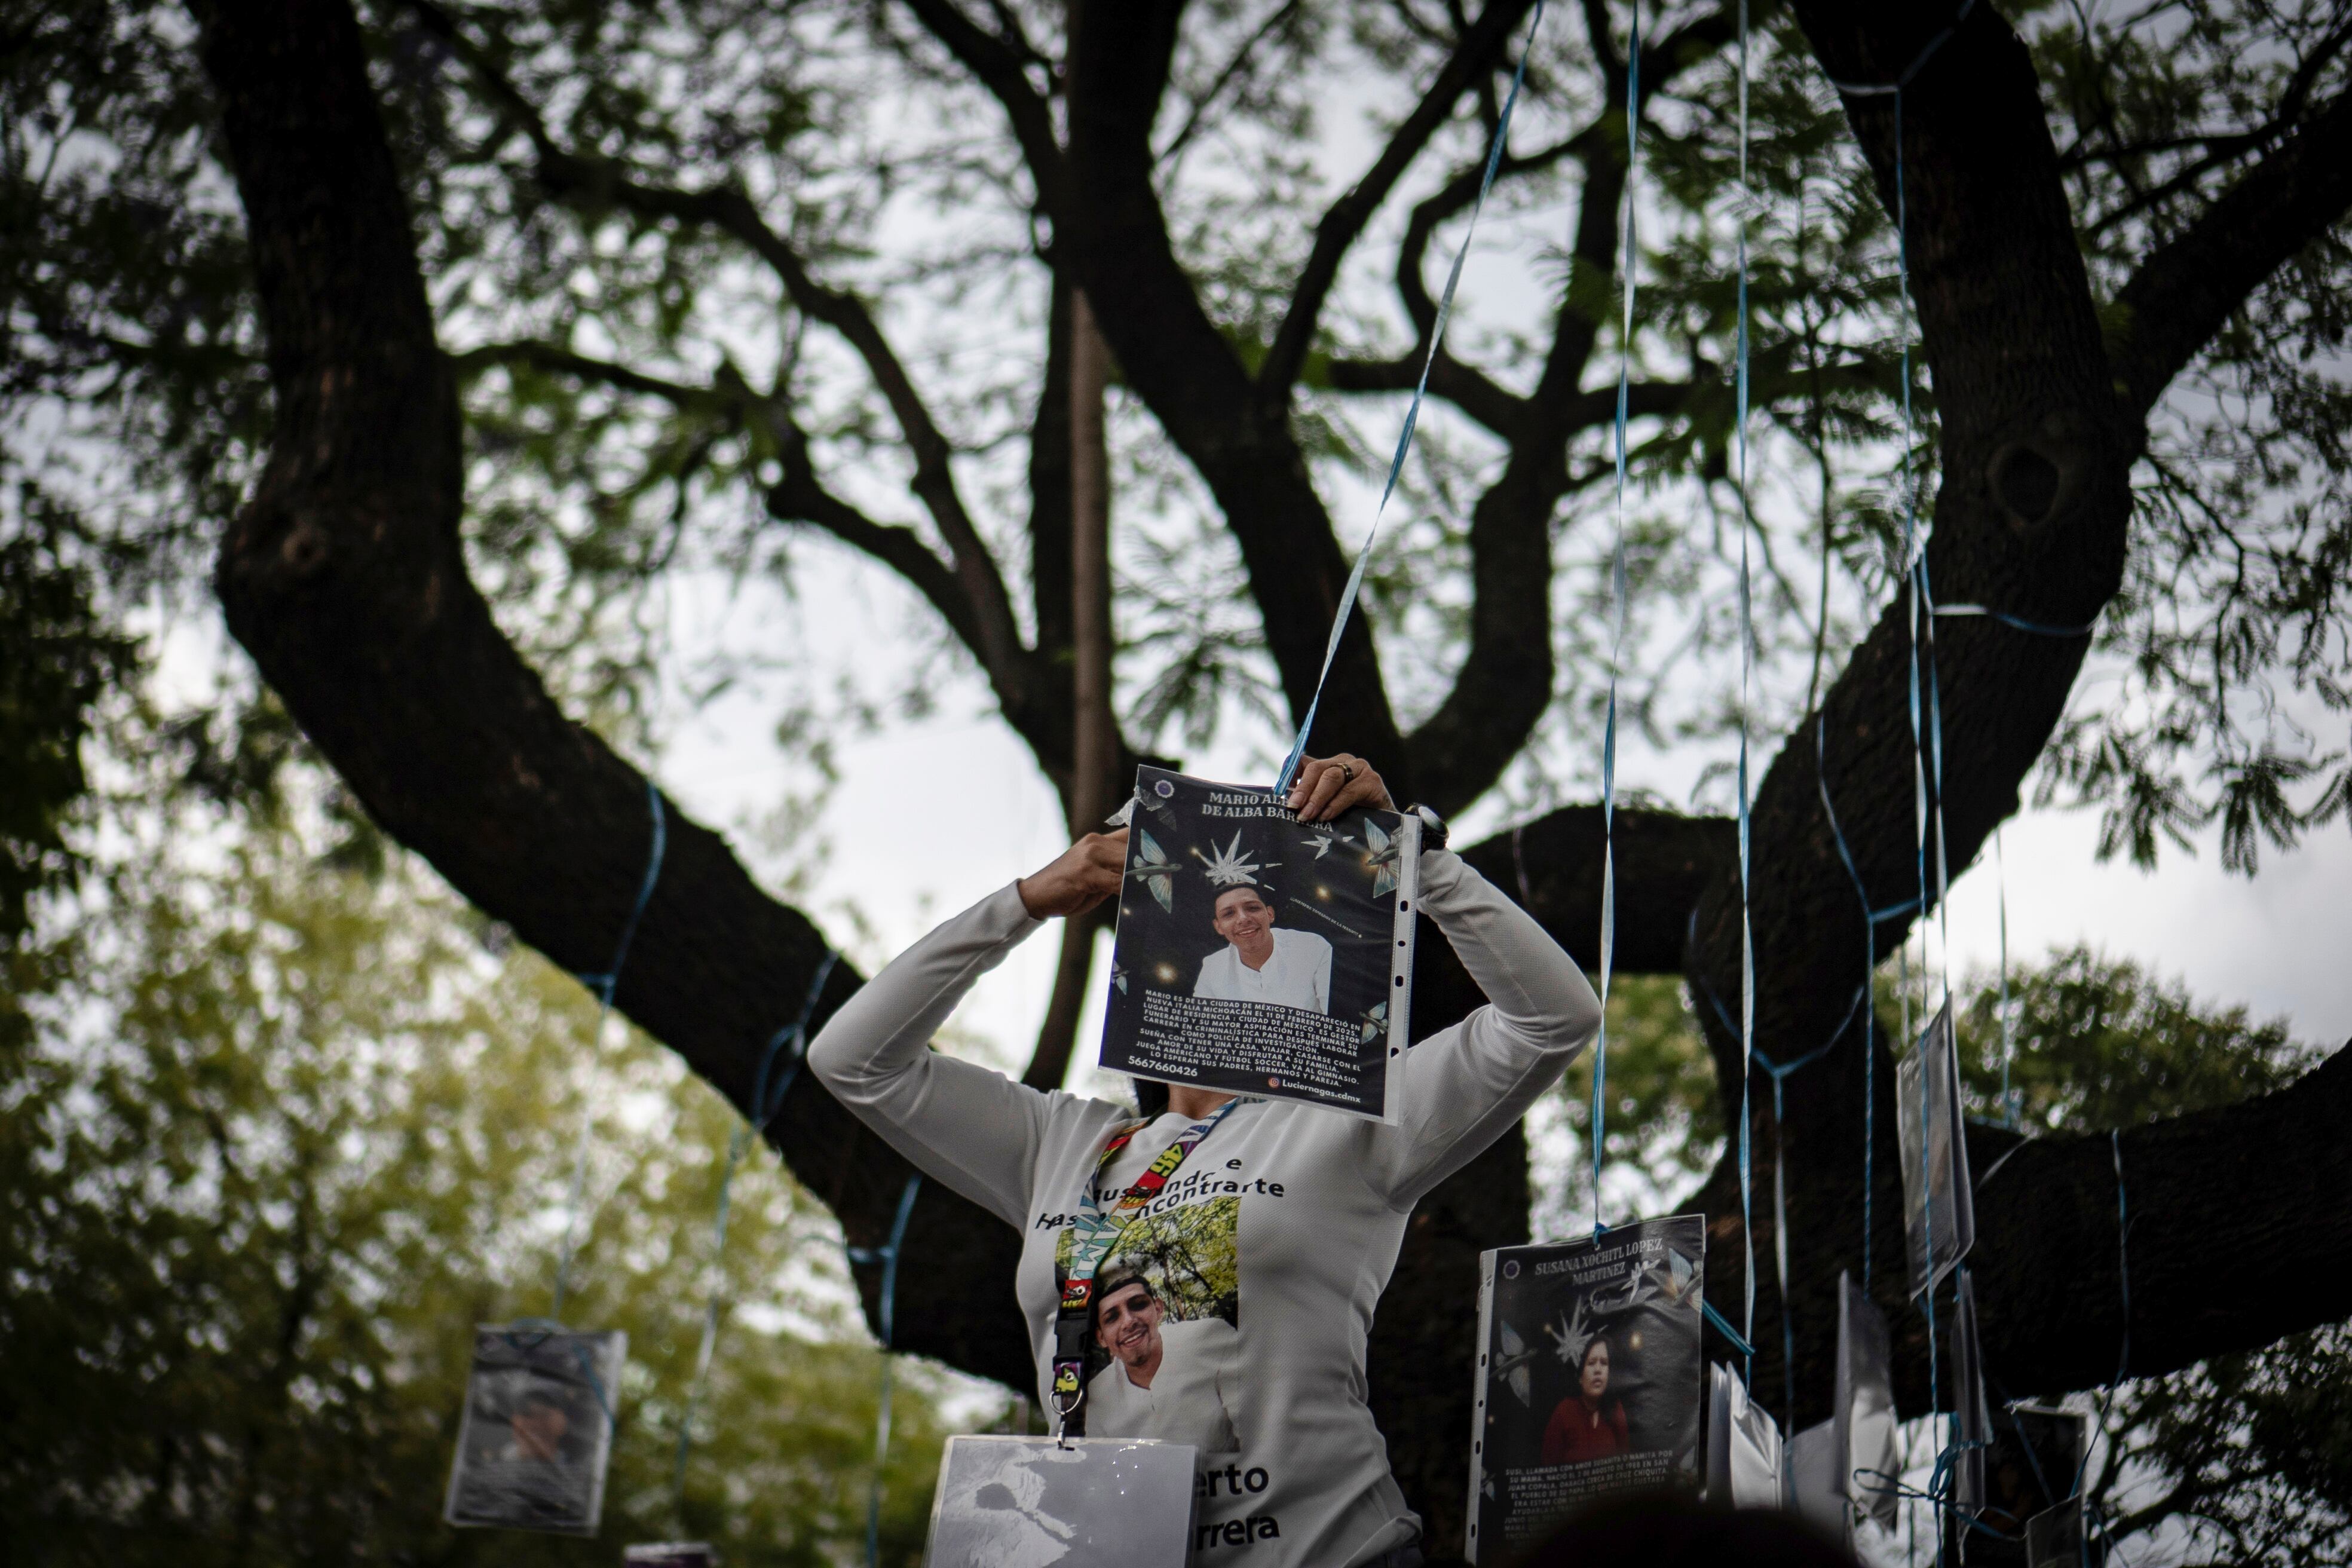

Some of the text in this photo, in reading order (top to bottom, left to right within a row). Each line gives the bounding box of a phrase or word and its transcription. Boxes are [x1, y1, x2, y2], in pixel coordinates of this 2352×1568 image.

[1202, 804, 1221, 816] DE
[1225, 807, 1263, 817] ALBA
[1209, 792, 1259, 805] MARIO
[1143, 1002, 1169, 1012] LUGAR
[1184, 1011, 1230, 1021] RESIDENCIA
[1239, 1016, 1268, 1024] CIUDAD
[1284, 1022, 1316, 1033] MÉXICO.
[1331, 1032, 1359, 1044] GESTOR
[1146, 990, 1171, 999] MARIO
[1255, 1003, 1285, 1013] MÉXICO
[1296, 1010, 1348, 1027] DESAPARECIÓ
[1147, 997, 1172, 1006] NUEVA
[1175, 1003, 1200, 1011] ITALIA
[1203, 1007, 1252, 1015] MICHOACÁN
[1288, 1016, 1321, 1027] FEBRERO
[1336, 1027, 1358, 1037] 2025.
[1143, 1016, 1179, 1028] CARRERA
[1195, 1025, 1259, 1037] CRIMINALÍSTICA
[1287, 1036, 1319, 1048] DESPUÉS
[1322, 1043, 1357, 1057] LABORAR
[1144, 1009, 1189, 1022] FUNERARIO
[1244, 1024, 1293, 1035] ASPIRACIÓN
[1307, 1033, 1345, 1047] TERMINAR
[1181, 1030, 1205, 1039] COMO
[1208, 1033, 1239, 1042] POLICÍA
[1255, 1038, 1319, 1054] INVESTIGACIÓN.
[1137, 1041, 1160, 1051] JUEGA
[1164, 1047, 1211, 1059] AMÉRICANO
[1222, 1054, 1251, 1064] FÚTBOL
[1318, 1070, 1359, 1085] GIMNASIO.
[1140, 1028, 1165, 1038] SUEÑA
[1189, 1037, 1212, 1046] TENER
[1296, 1051, 1331, 1064] CASARSE
[1334, 1060, 1350, 1069] CON
[1158, 1039, 1181, 1048] AMOR
[1239, 1051, 1282, 1061] DISFRUTAR
[1306, 1060, 1340, 1073] FAMILIA.
[1128, 1056, 1198, 1077] 5667660426
[1163, 1053, 1198, 1064] ESPERAN
[1219, 1062, 1252, 1071] PADRES,
[1256, 1066, 1300, 1077] HERMANOS
[1310, 1074, 1342, 1088] PAREJA.
[1282, 1079, 1361, 1103] Luciernagas.cdmx
[1137, 1178, 1284, 1219] ncontrarte
[1535, 1238, 1663, 1275] SUSANA XOCHITL LOPEZ
[1572, 1261, 1626, 1285] MARTINEZ
[1592, 1465, 1615, 1474] AGOSTO
[1630, 1451, 1655, 1460] MAMITA
[1195, 1464, 1269, 1497] erto
[1587, 1475, 1604, 1484] CERCA
[1616, 1471, 1631, 1479] CRUZ
[1196, 1516, 1280, 1551] rrera
